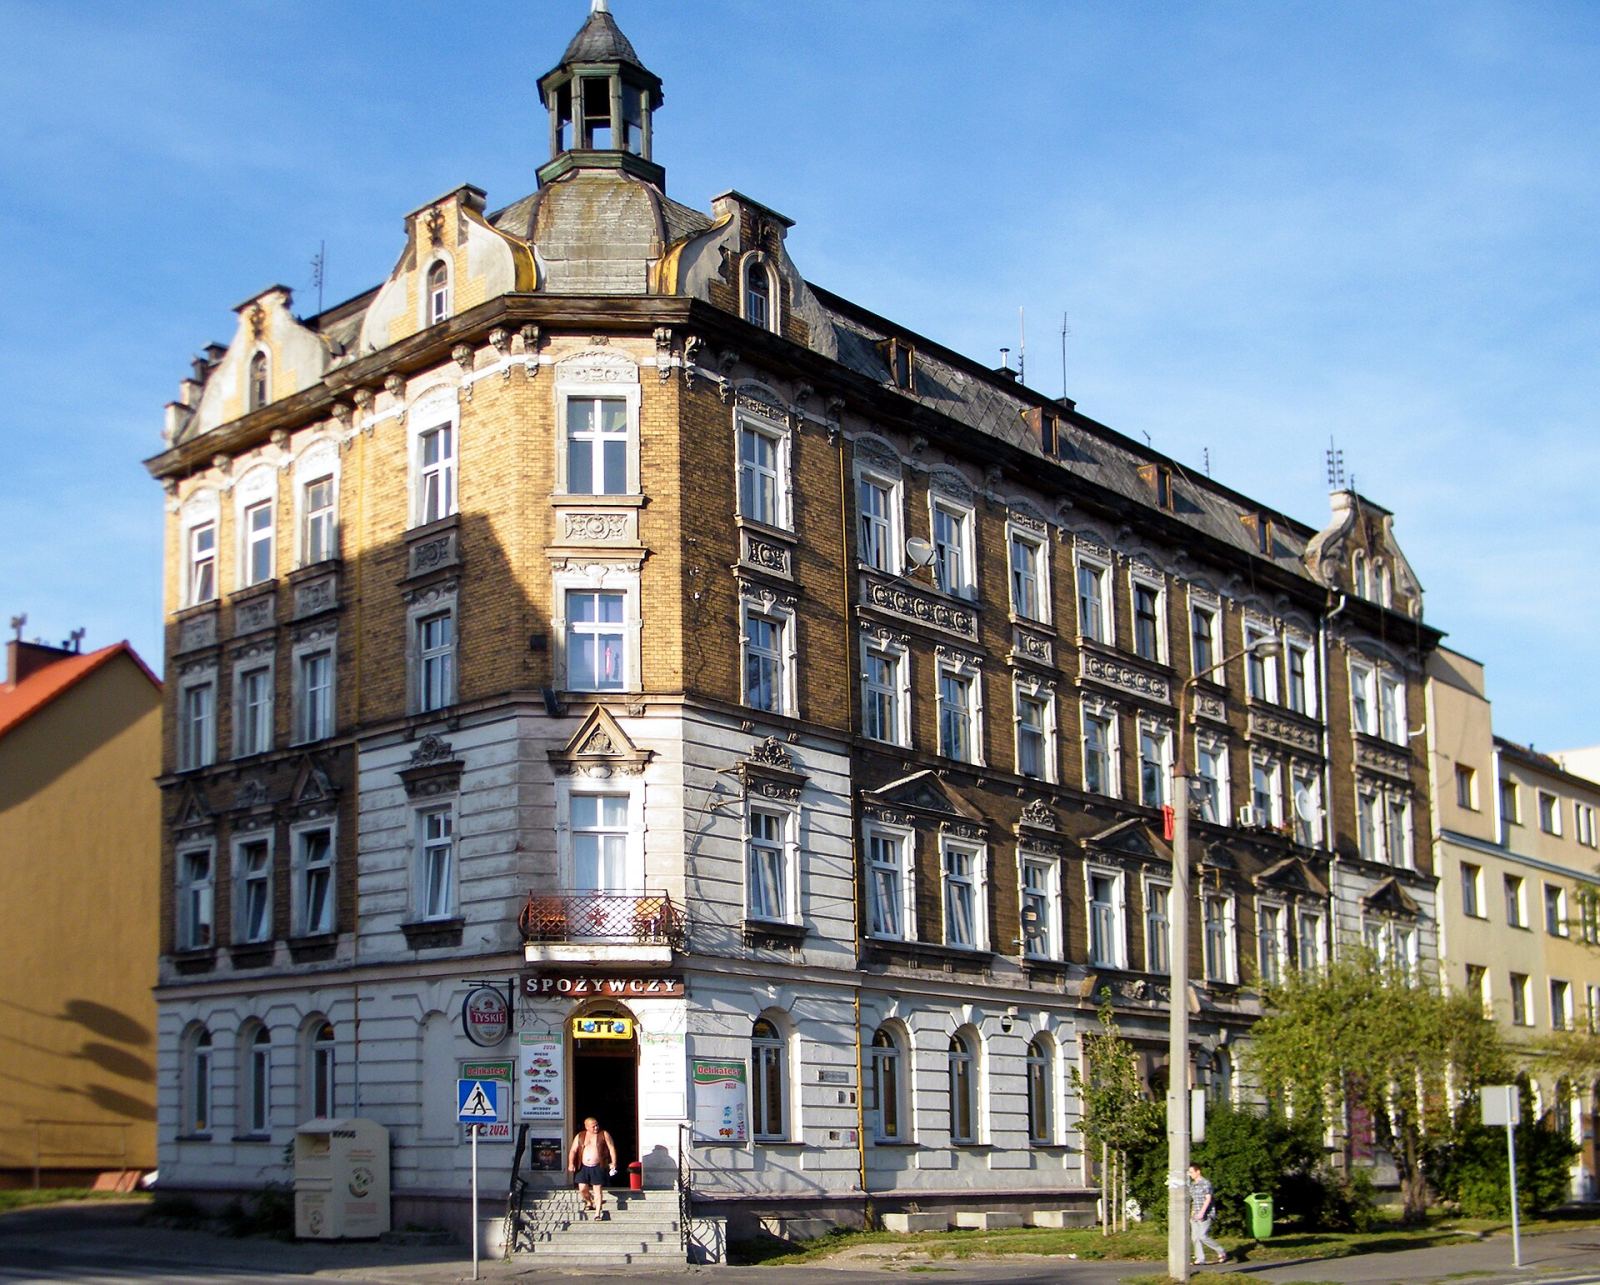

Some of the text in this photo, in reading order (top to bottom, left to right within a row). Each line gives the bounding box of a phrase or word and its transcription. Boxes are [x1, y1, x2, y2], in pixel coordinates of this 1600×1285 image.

[526, 976, 677, 992] SPOŻYWCZY
[473, 1012, 505, 1023] TYSKIE
[578, 1020, 625, 1034] LOTTO
[467, 1067, 508, 1077] Delikatesy
[698, 1065, 742, 1076] Delikatesy
